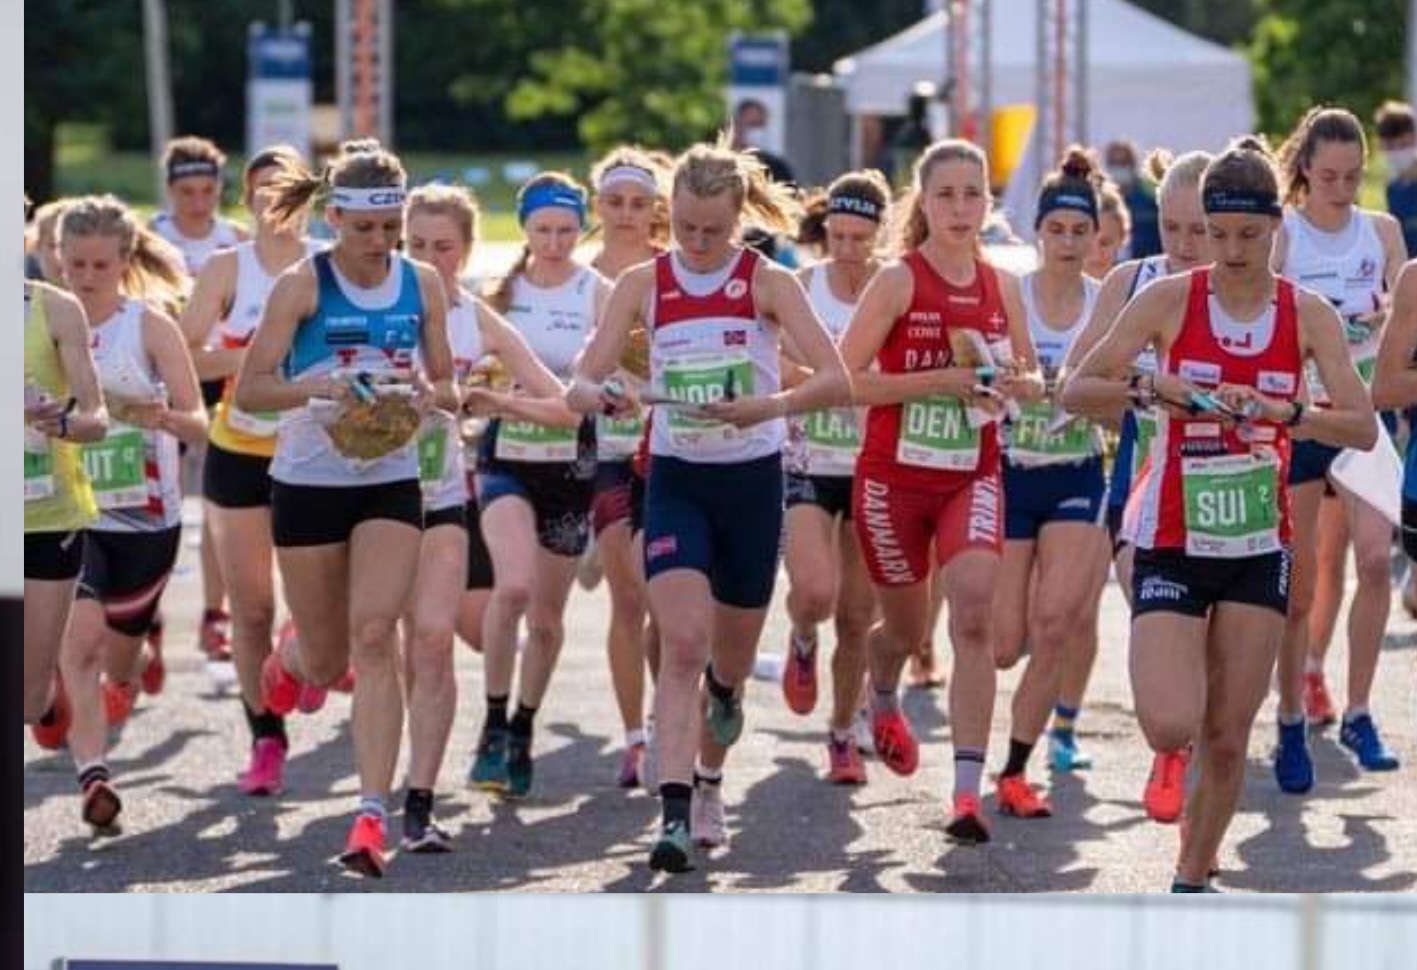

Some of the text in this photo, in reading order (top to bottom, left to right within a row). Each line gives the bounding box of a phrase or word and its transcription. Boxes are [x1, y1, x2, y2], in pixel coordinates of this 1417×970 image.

[908, 402, 962, 440] DEN
[1197, 488, 1247, 528] SUI
[864, 477, 916, 584] DANMARK
